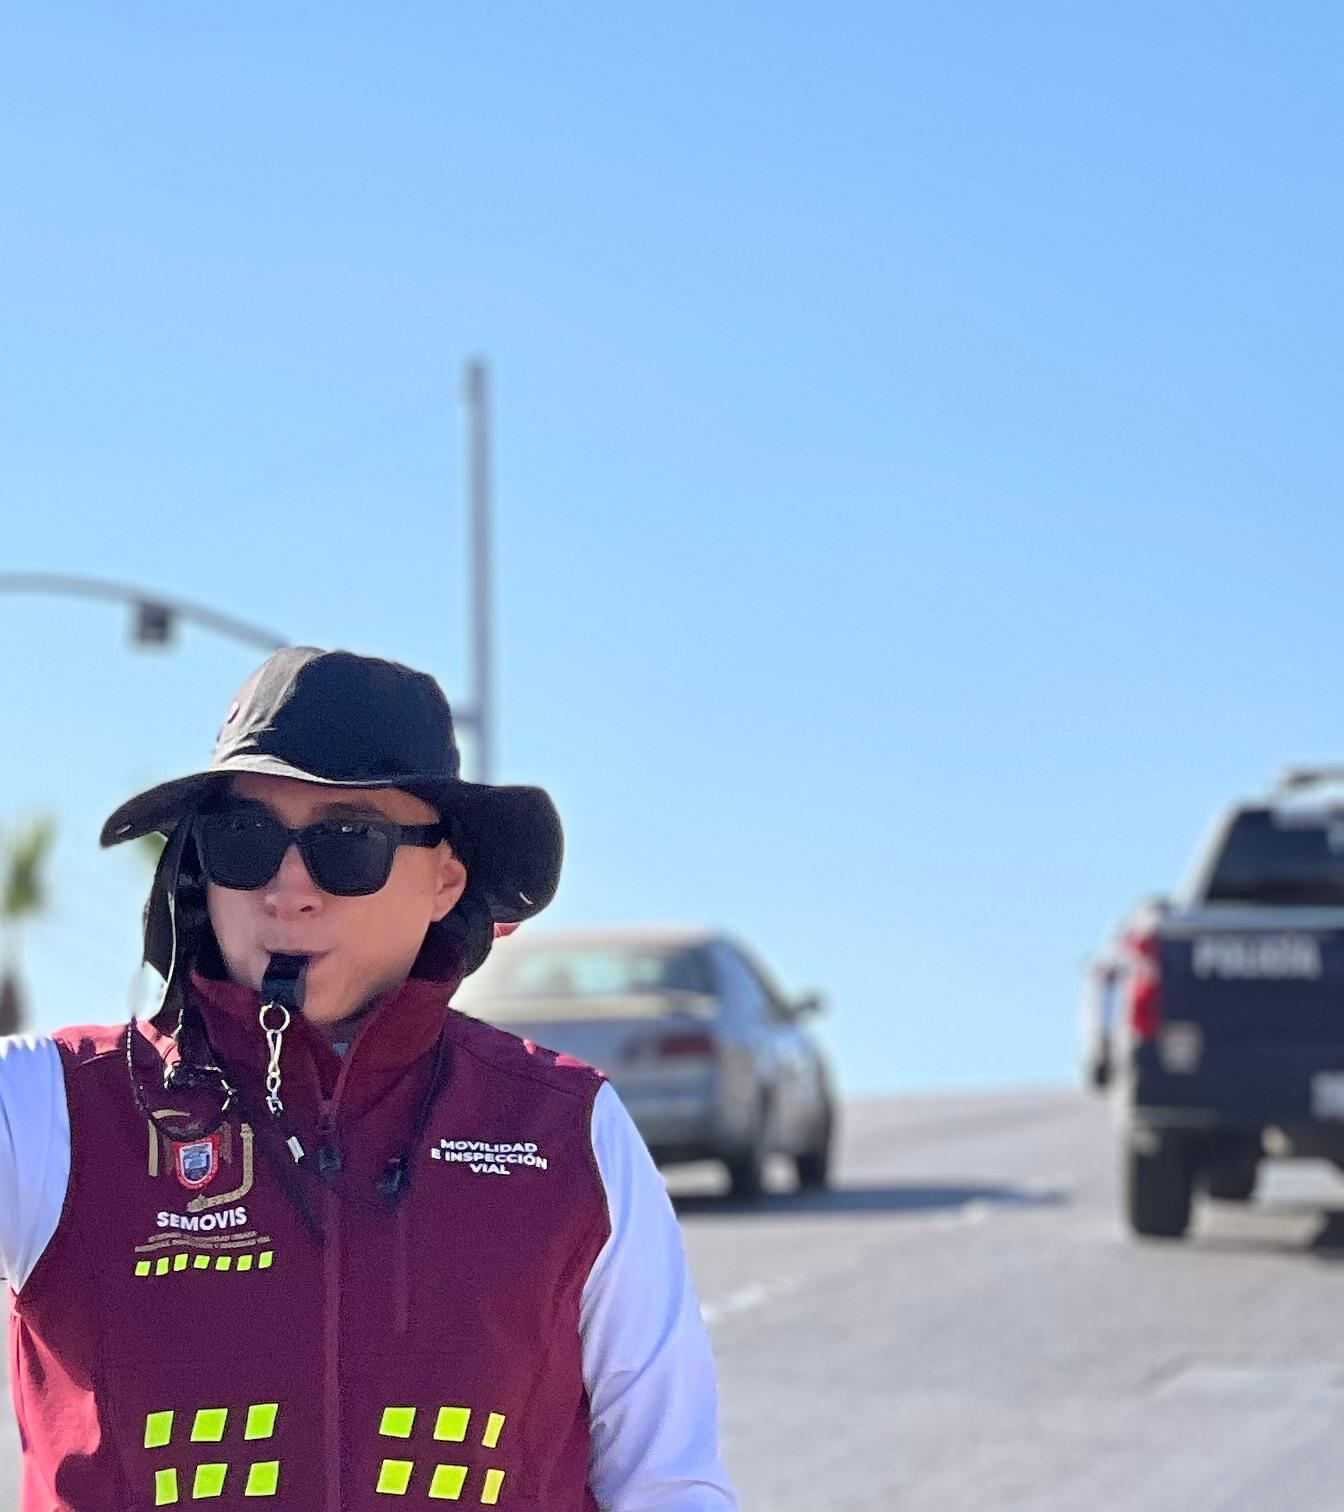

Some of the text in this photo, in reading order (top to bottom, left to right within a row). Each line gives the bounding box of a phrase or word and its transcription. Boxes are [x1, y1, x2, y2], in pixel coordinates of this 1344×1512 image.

[440, 1138, 538, 1153] MOVILIDAD
[431, 1147, 548, 1170] E INSPECCIÓN
[470, 1163, 511, 1175] VIAL
[156, 1206, 248, 1231] SEMOVIS
